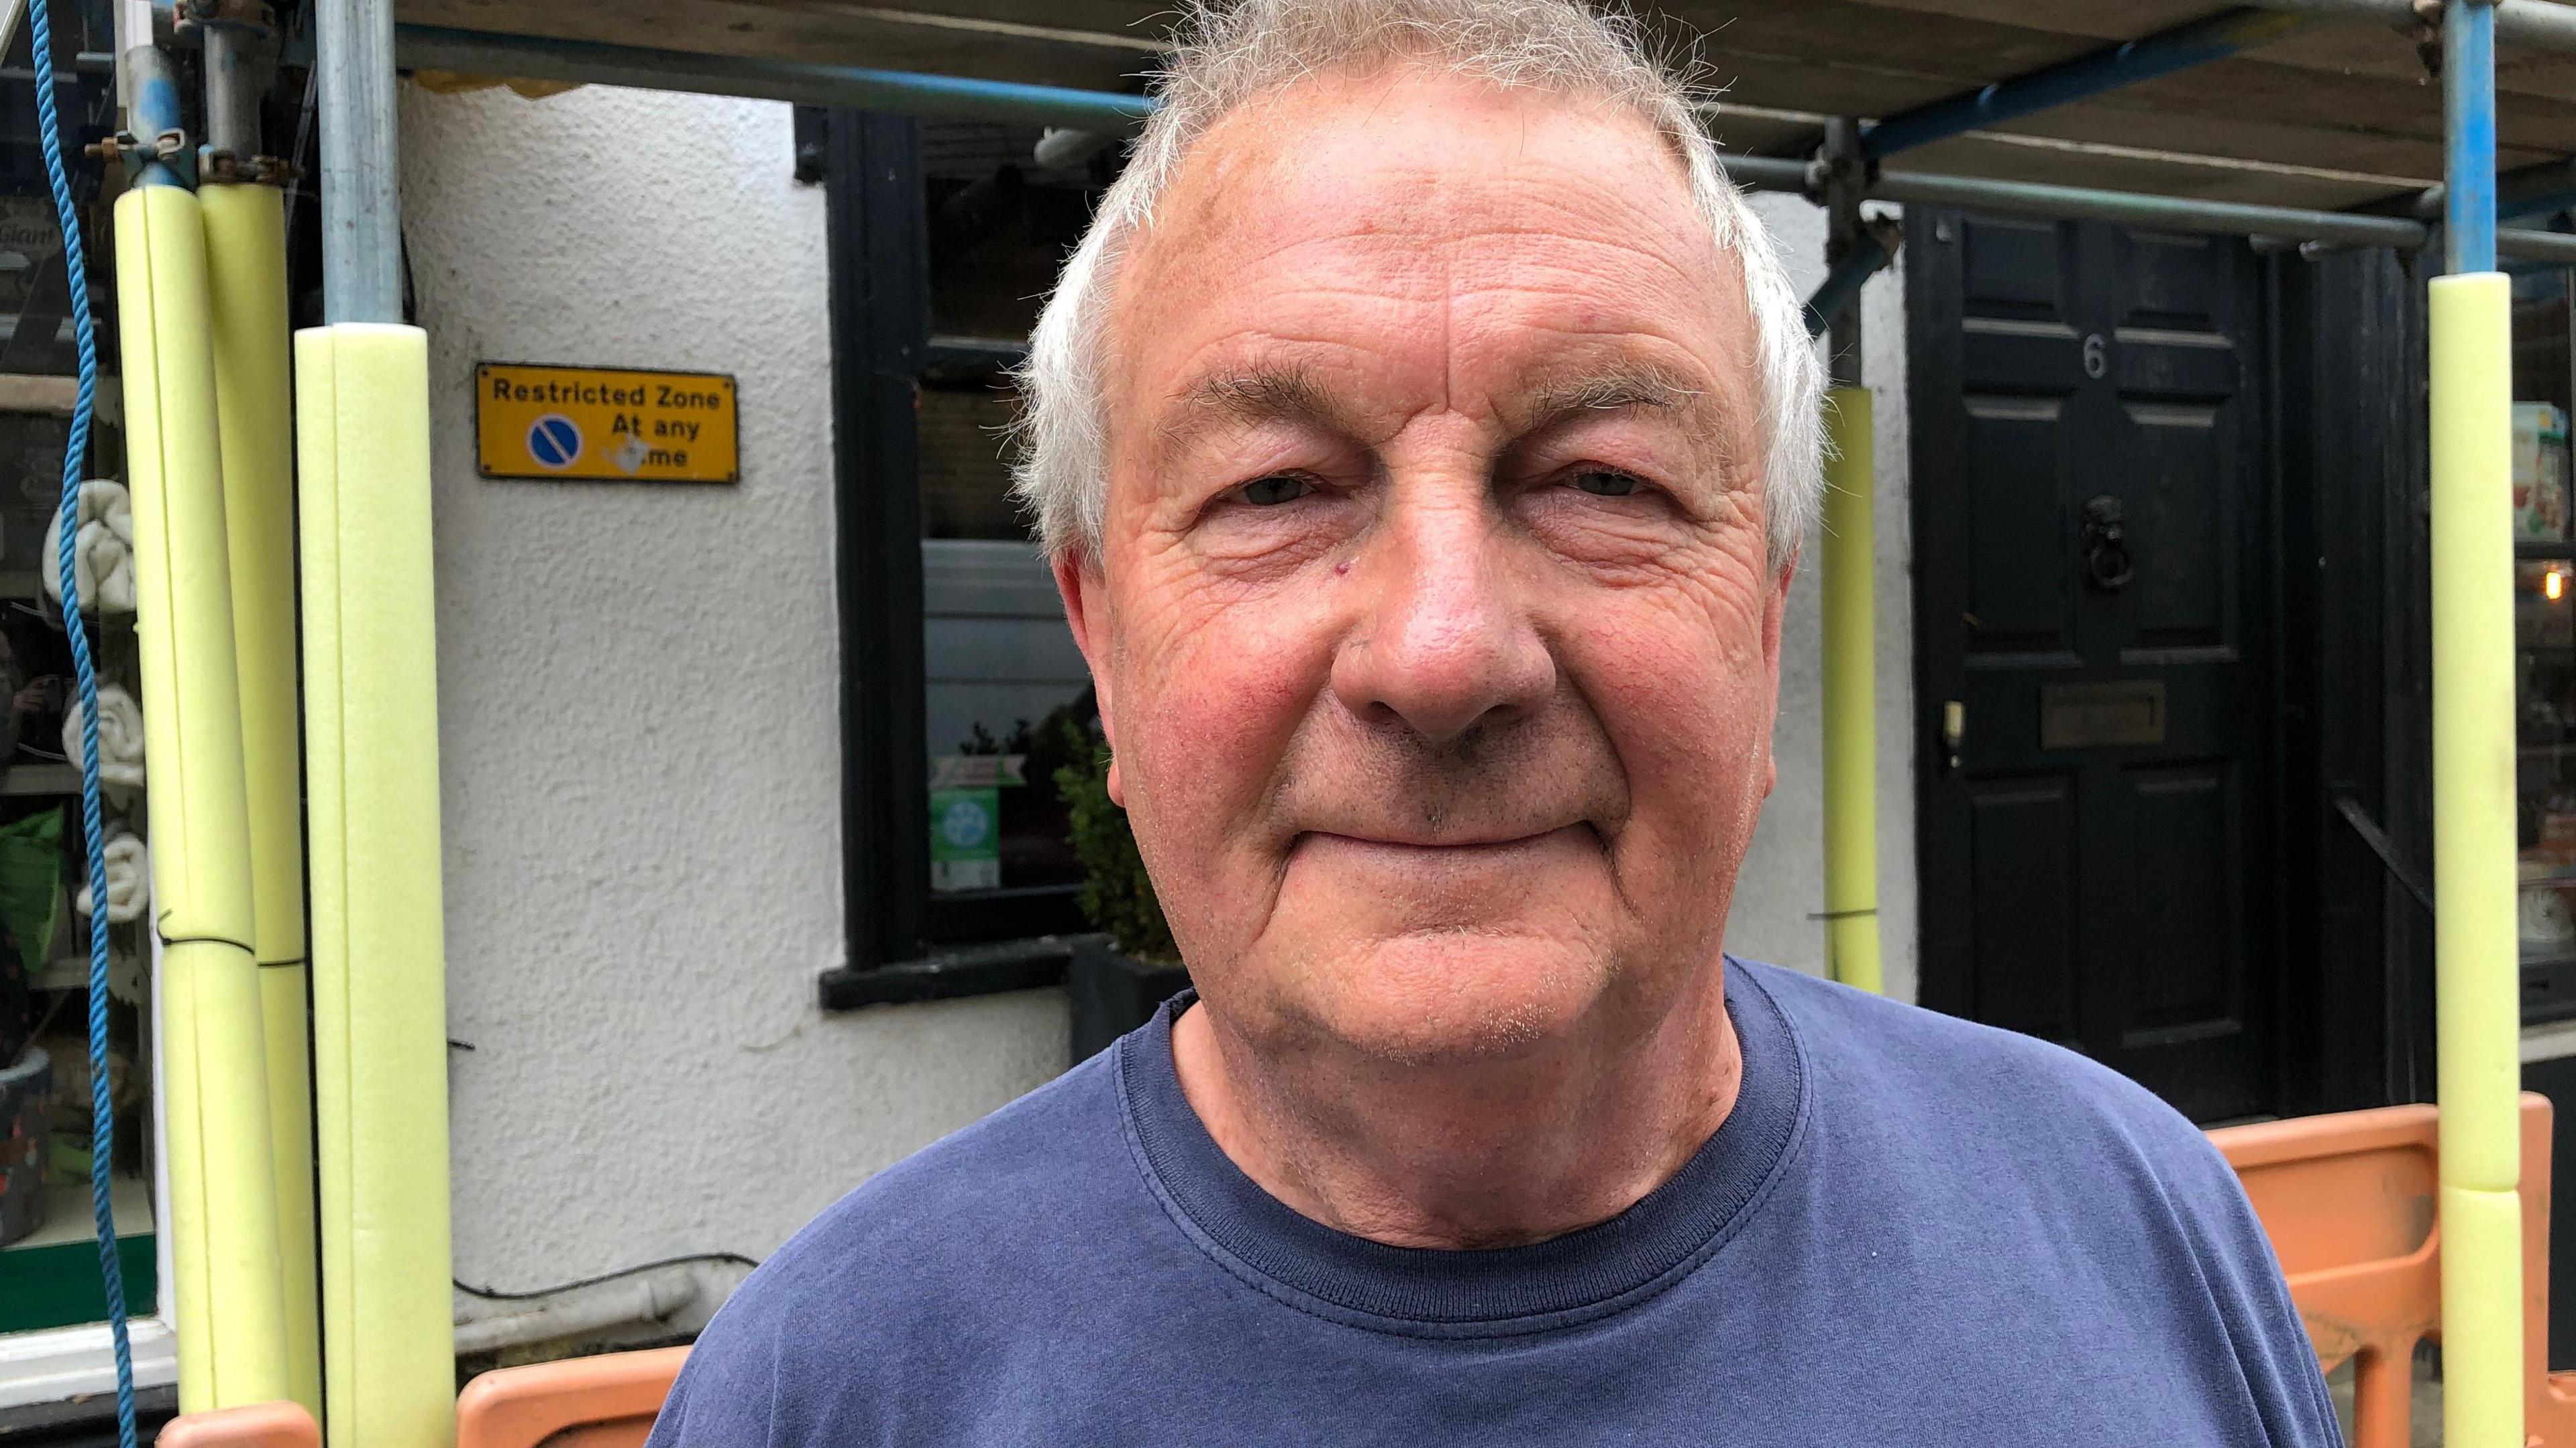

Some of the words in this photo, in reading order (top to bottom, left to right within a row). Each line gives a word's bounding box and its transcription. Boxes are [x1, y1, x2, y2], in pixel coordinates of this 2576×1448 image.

[2083, 333, 2106, 380] 6
[493, 377, 645, 406] Restricted
[656, 384, 720, 410] Zone
[612, 412, 641, 437] At
[654, 419, 700, 442] any
